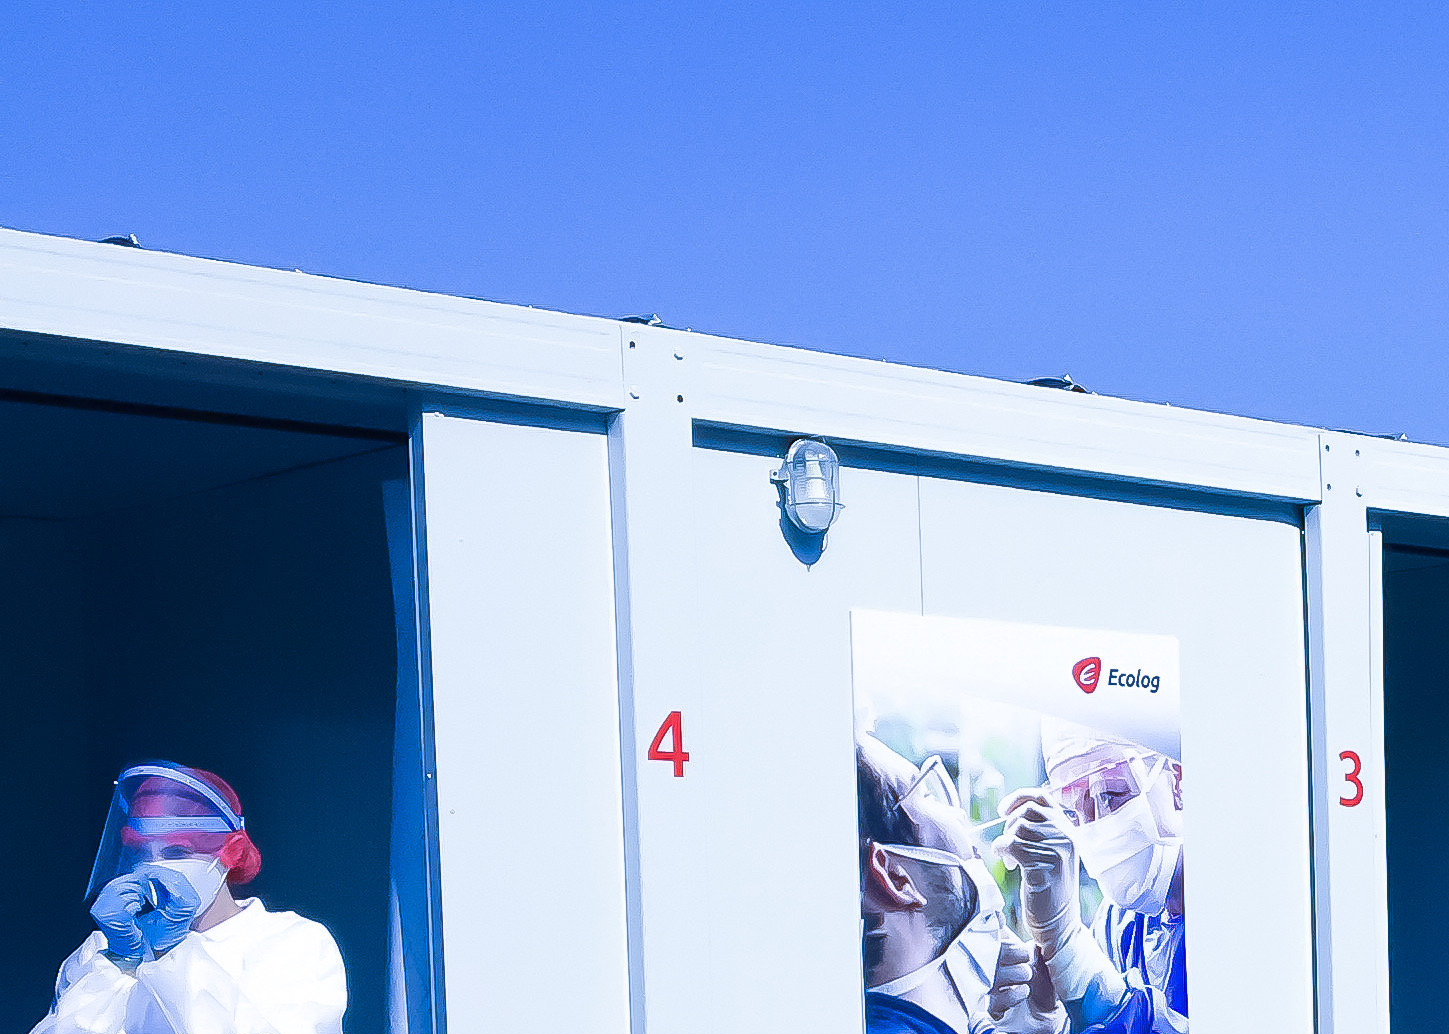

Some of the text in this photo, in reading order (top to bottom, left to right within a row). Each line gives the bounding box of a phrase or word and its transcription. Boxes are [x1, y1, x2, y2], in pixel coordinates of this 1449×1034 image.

[1107, 668, 1161, 694] Ecolog
[647, 710, 690, 777] 4
[1339, 750, 1364, 808] 3
